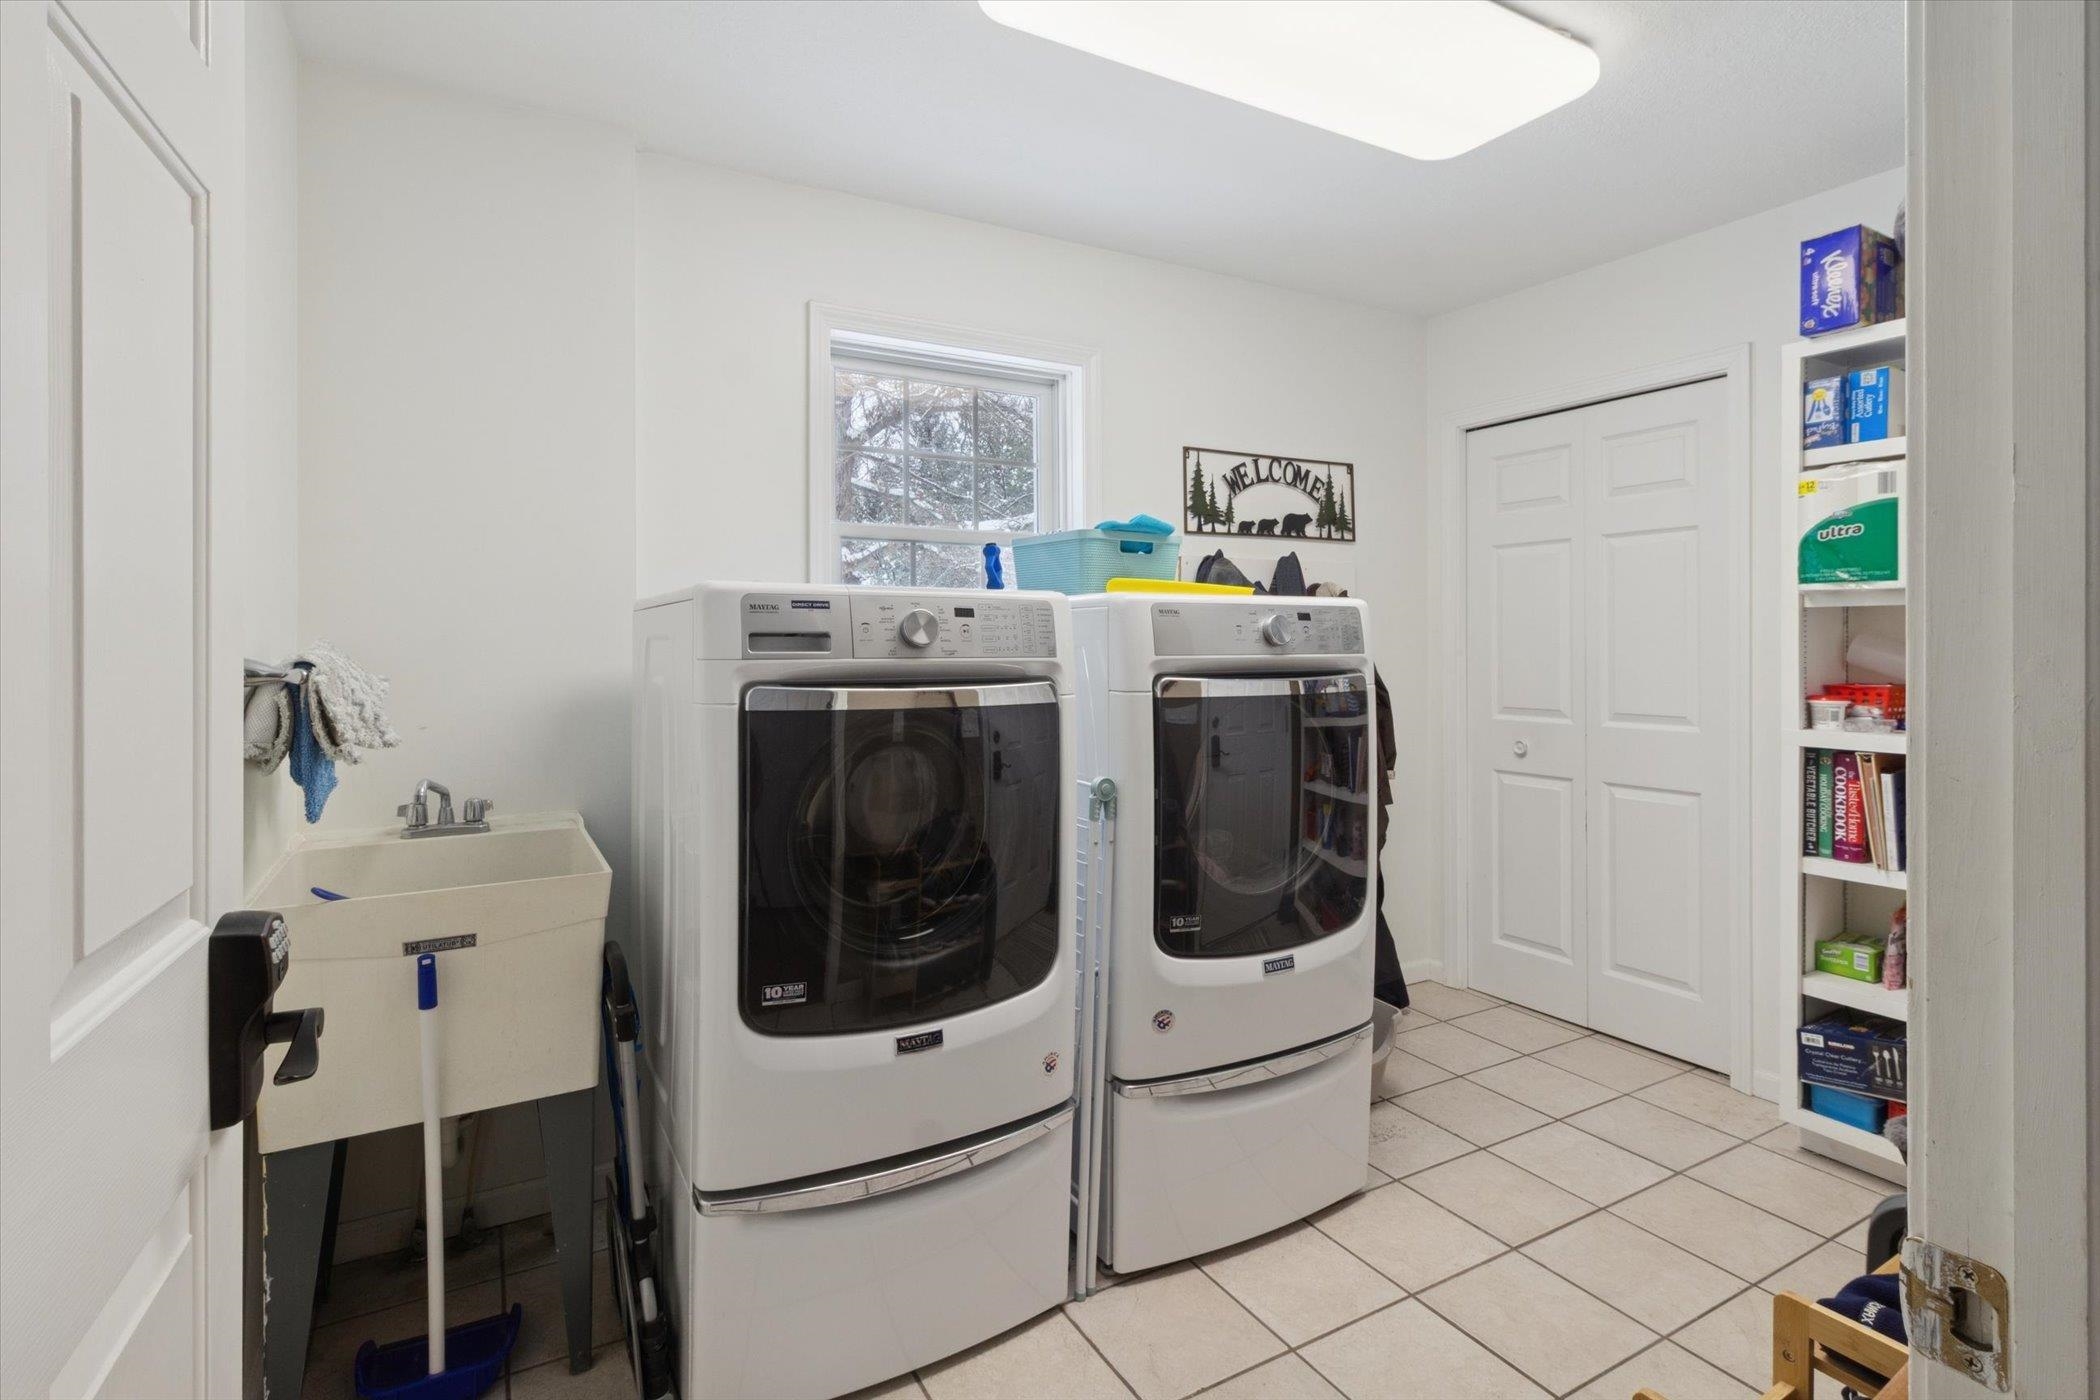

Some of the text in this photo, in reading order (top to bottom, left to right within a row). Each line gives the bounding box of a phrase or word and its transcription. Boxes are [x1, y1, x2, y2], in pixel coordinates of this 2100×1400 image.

[1820, 249, 1848, 318] Kleenex
[1856, 388, 1865, 418] Assorted
[1222, 457, 1326, 502] WELCOME
[1819, 524, 1863, 540] ultra
[1805, 765, 1817, 809] VEGETABLE
[1848, 780, 1861, 806] Taste
[1834, 766, 1847, 842] COOKBOOK
[1805, 809, 1817, 841] BUTCHER
[1847, 813, 1861, 842] Home
[1171, 917, 1185, 927] 10
[1265, 958, 1294, 972] MAYTAG
[764, 987, 782, 999] 10
[783, 984, 805, 992] YEAR
